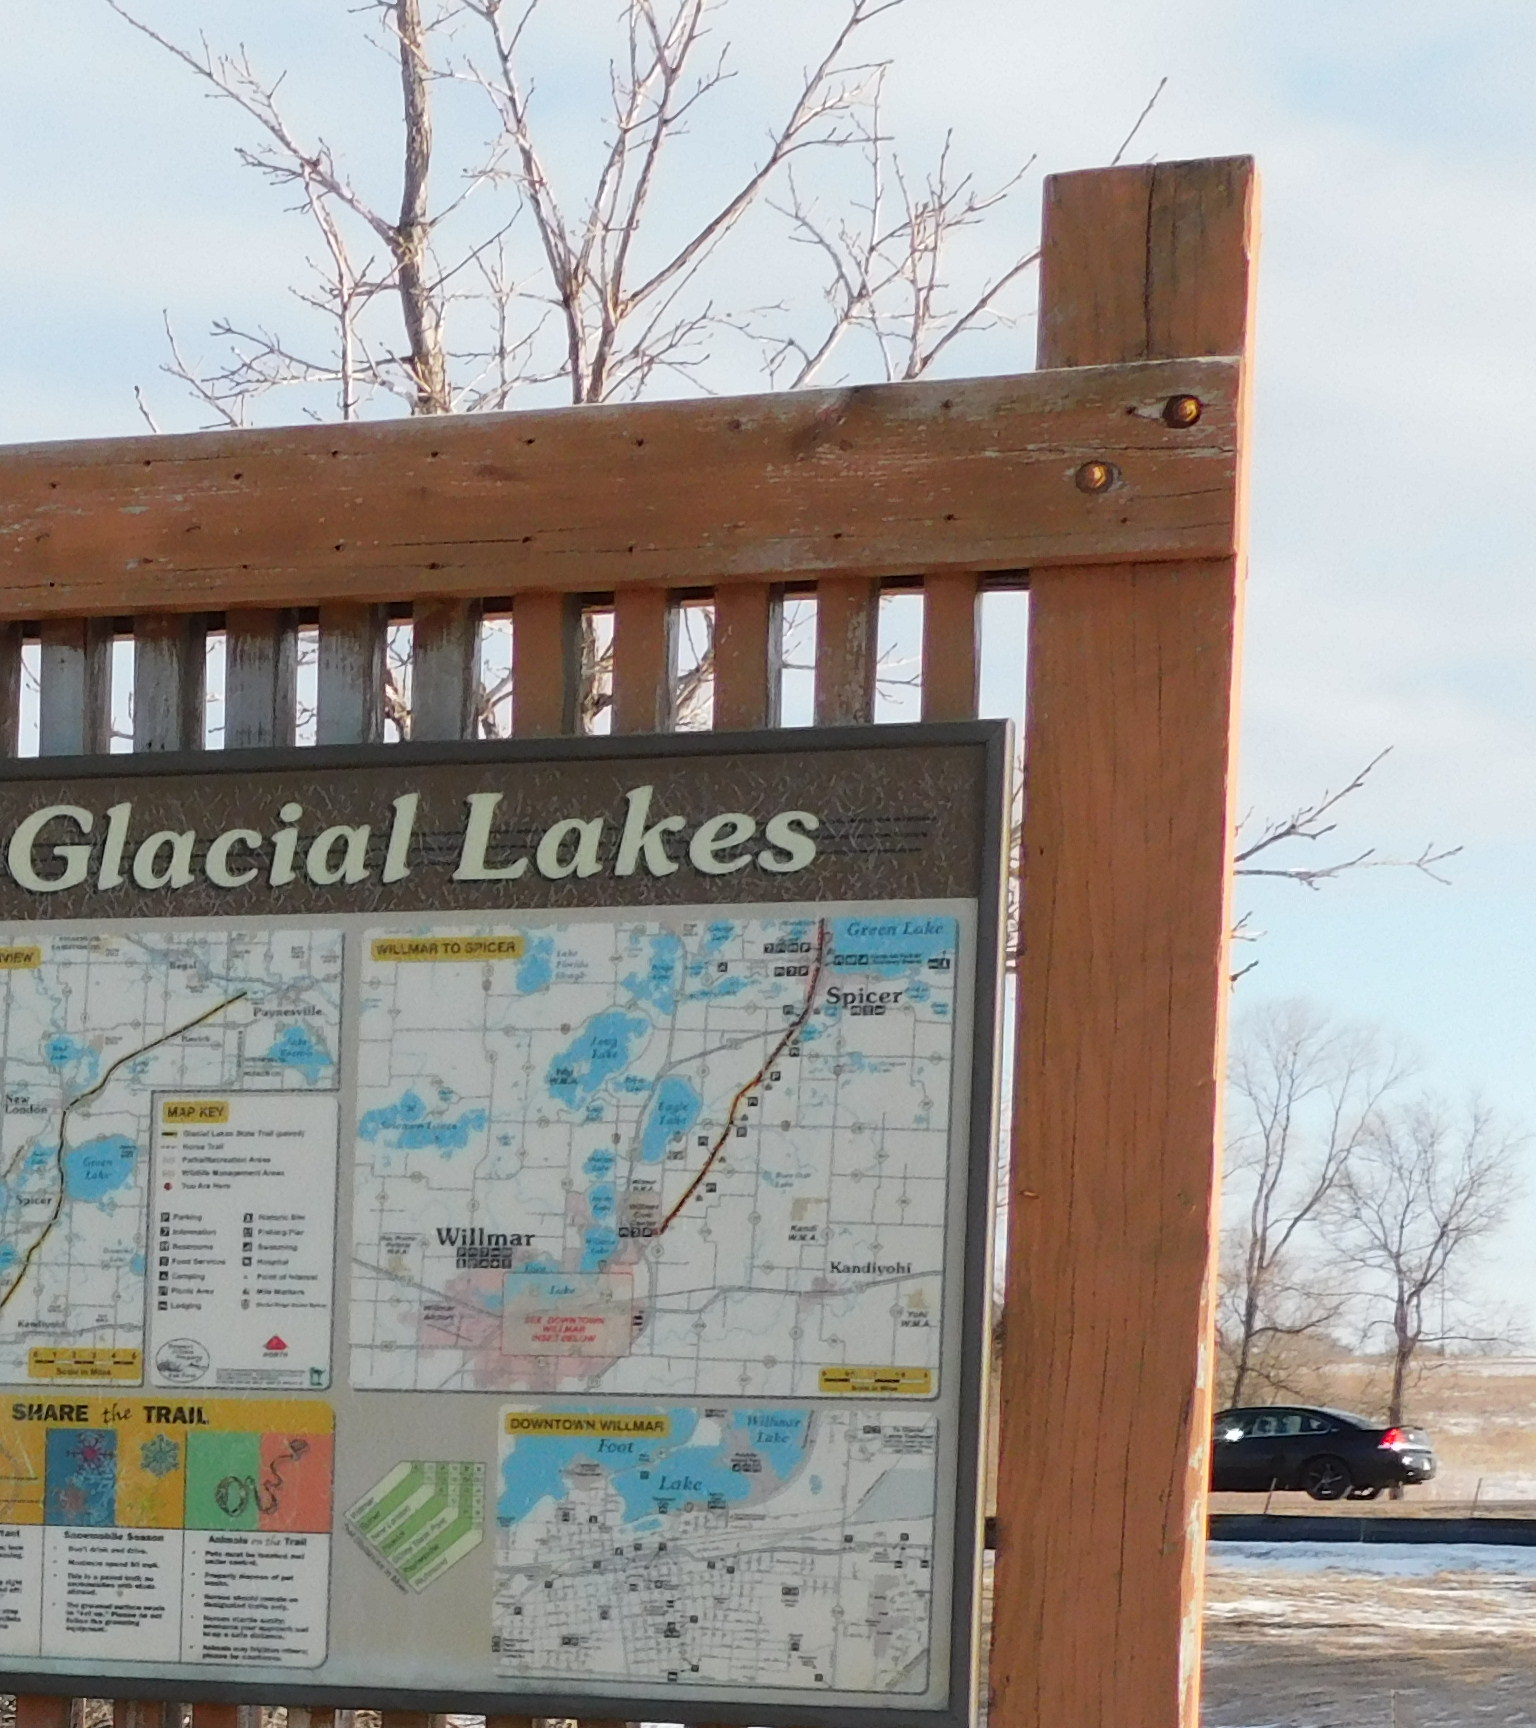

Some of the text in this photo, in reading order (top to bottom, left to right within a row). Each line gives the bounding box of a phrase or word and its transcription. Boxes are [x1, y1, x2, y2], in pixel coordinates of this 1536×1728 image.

[8, 788, 820, 894] Glacial Lakes
[847, 921, 943, 936] Green Lake
[377, 941, 515, 955] WILLMAR TO SPICER
[825, 986, 904, 1008] Spicer
[253, 1004, 322, 1017] Paynesville
[5, 1103, 47, 1113] London
[168, 1106, 223, 1117] MAP KEY
[16, 1193, 52, 1206] Spicer
[437, 1227, 535, 1250] Willmar
[830, 1261, 912, 1276] Kandiyohi
[12, 1403, 210, 1425] SHARE the TRAIL
[510, 1418, 663, 1431] DOWNTOWN WILLMAR
[659, 1476, 702, 1491] Lake
